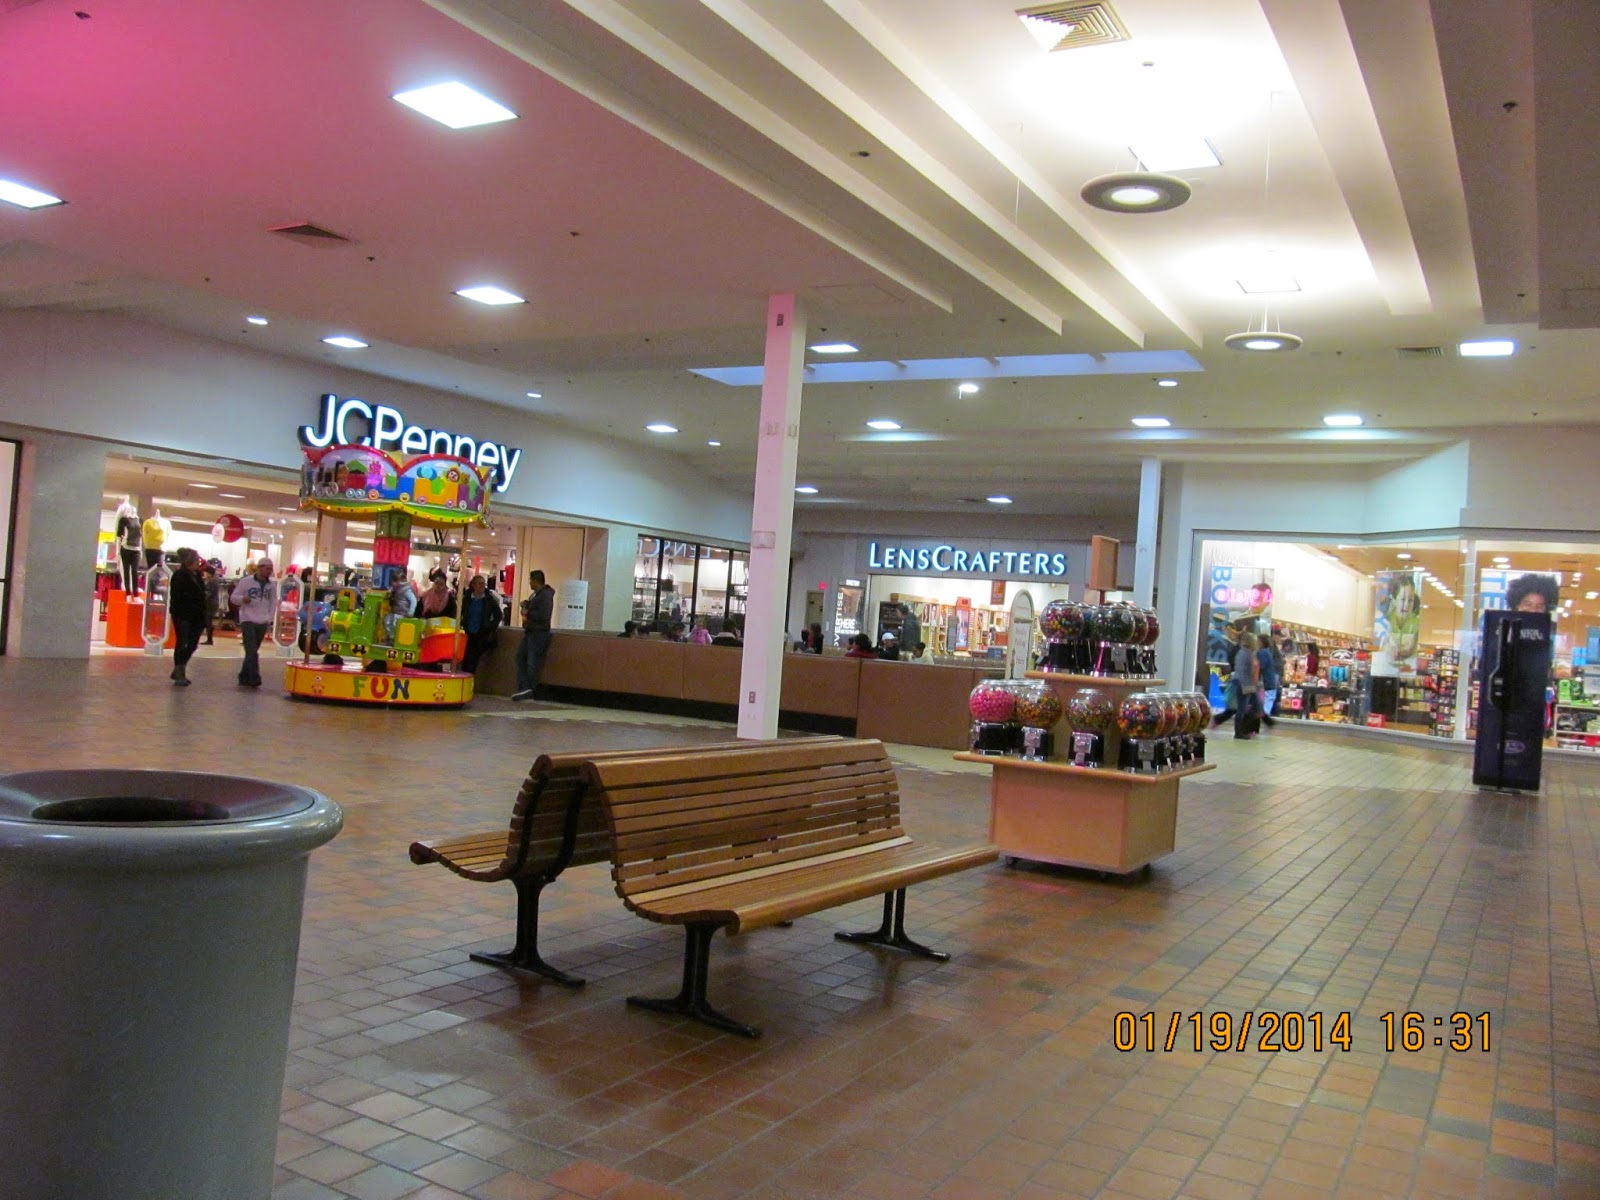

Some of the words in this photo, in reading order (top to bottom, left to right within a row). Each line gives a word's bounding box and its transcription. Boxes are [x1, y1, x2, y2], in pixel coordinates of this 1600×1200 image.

[302, 394, 523, 492] JCPenney
[869, 542, 1067, 577] LENSCRAFTERS
[1206, 566, 1232, 663] BOOKS
[353, 677, 410, 700] FUN
